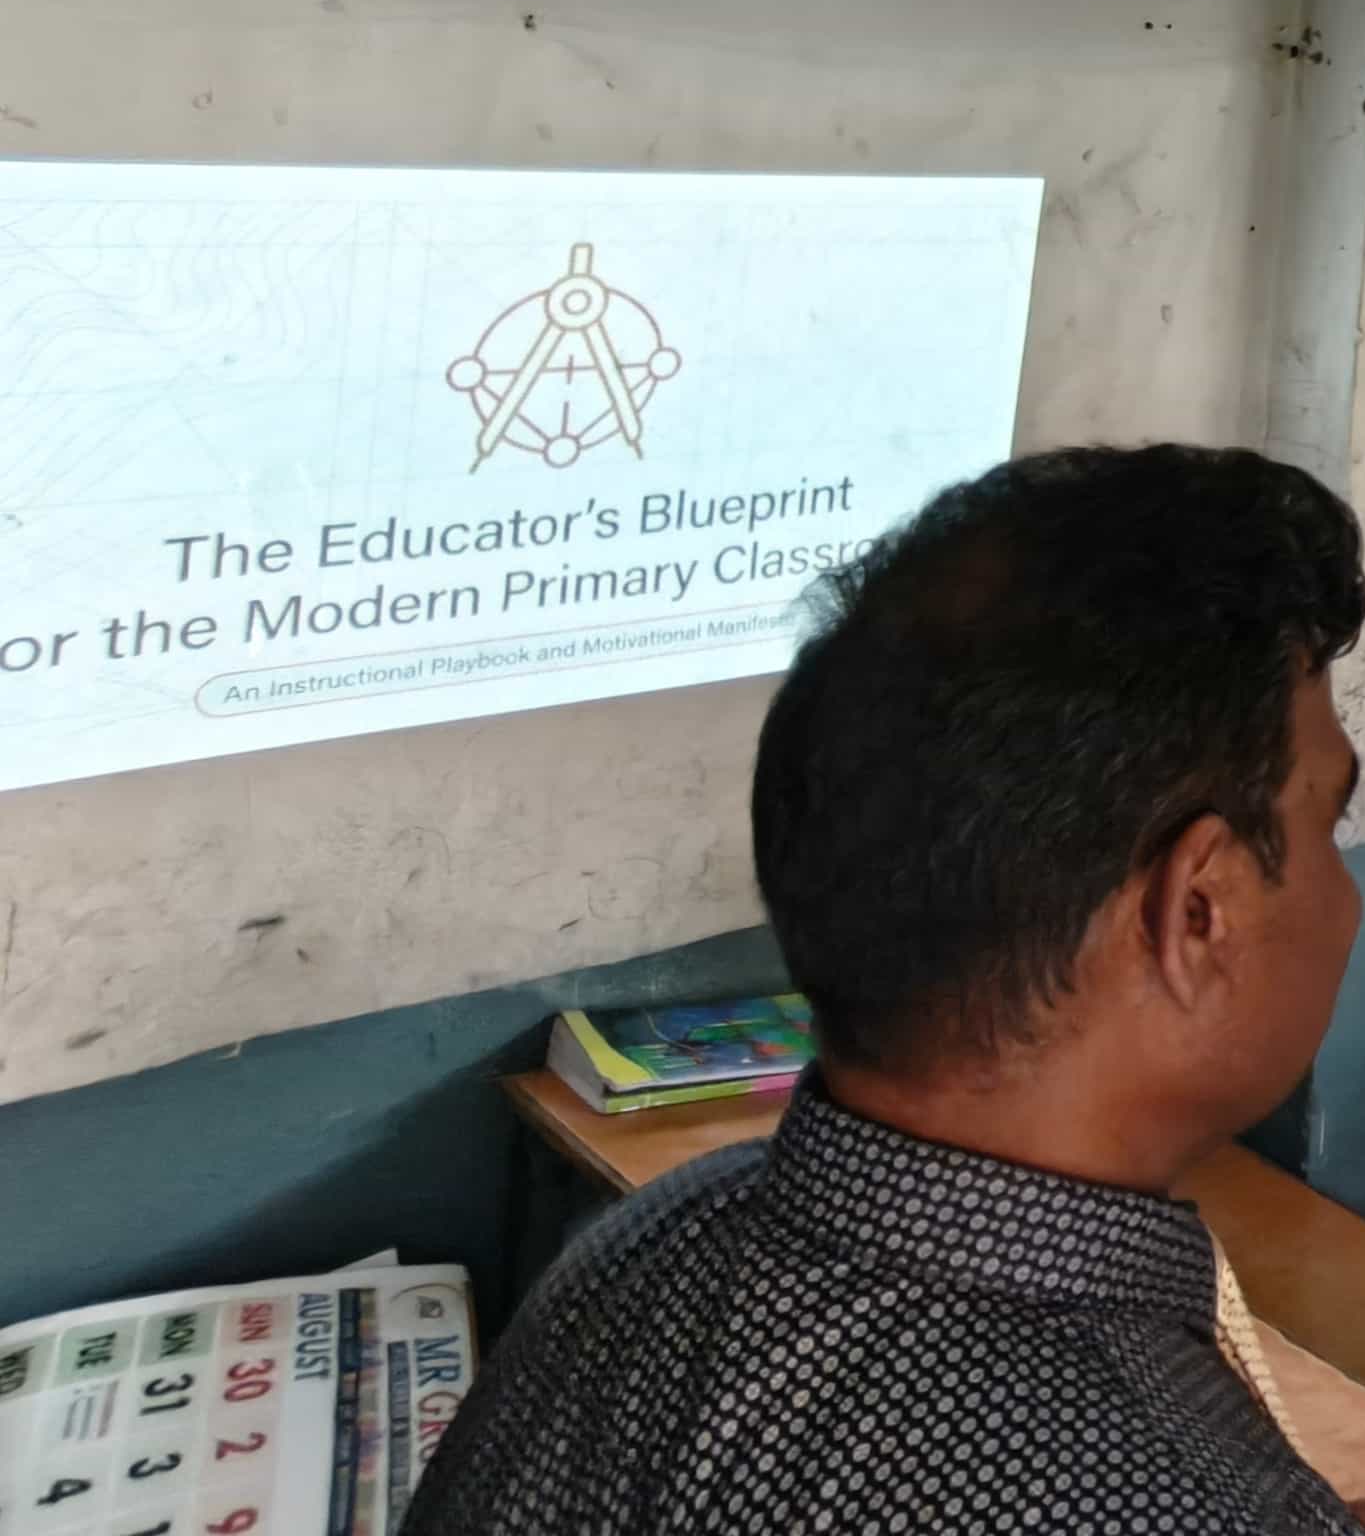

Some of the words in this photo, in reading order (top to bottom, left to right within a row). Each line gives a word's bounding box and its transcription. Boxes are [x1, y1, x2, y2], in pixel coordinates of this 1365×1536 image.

[163, 532, 294, 582] The
[318, 497, 620, 569] Educator's
[639, 475, 854, 536] Blueprint
[101, 609, 218, 660] the
[243, 584, 481, 644] Modern
[502, 563, 699, 613] Primary
[223, 684, 260, 705] An
[269, 659, 423, 698] Instructional
[430, 645, 530, 675] Playbook
[536, 638, 576, 662] and
[582, 622, 702, 657] Motivational
[158, 1313, 198, 1357] MON
[238, 1303, 274, 1343] SUN
[294, 1292, 333, 1381] AUGUST
[76, 1331, 119, 1370] TUE
[415, 1335, 461, 1387] MR
[139, 1373, 195, 1417] 31
[224, 1357, 274, 1403] 30
[127, 1452, 184, 1480] 3
[215, 1432, 267, 1461] 2
[36, 1478, 93, 1507] 4
[205, 1507, 260, 1536] 9
